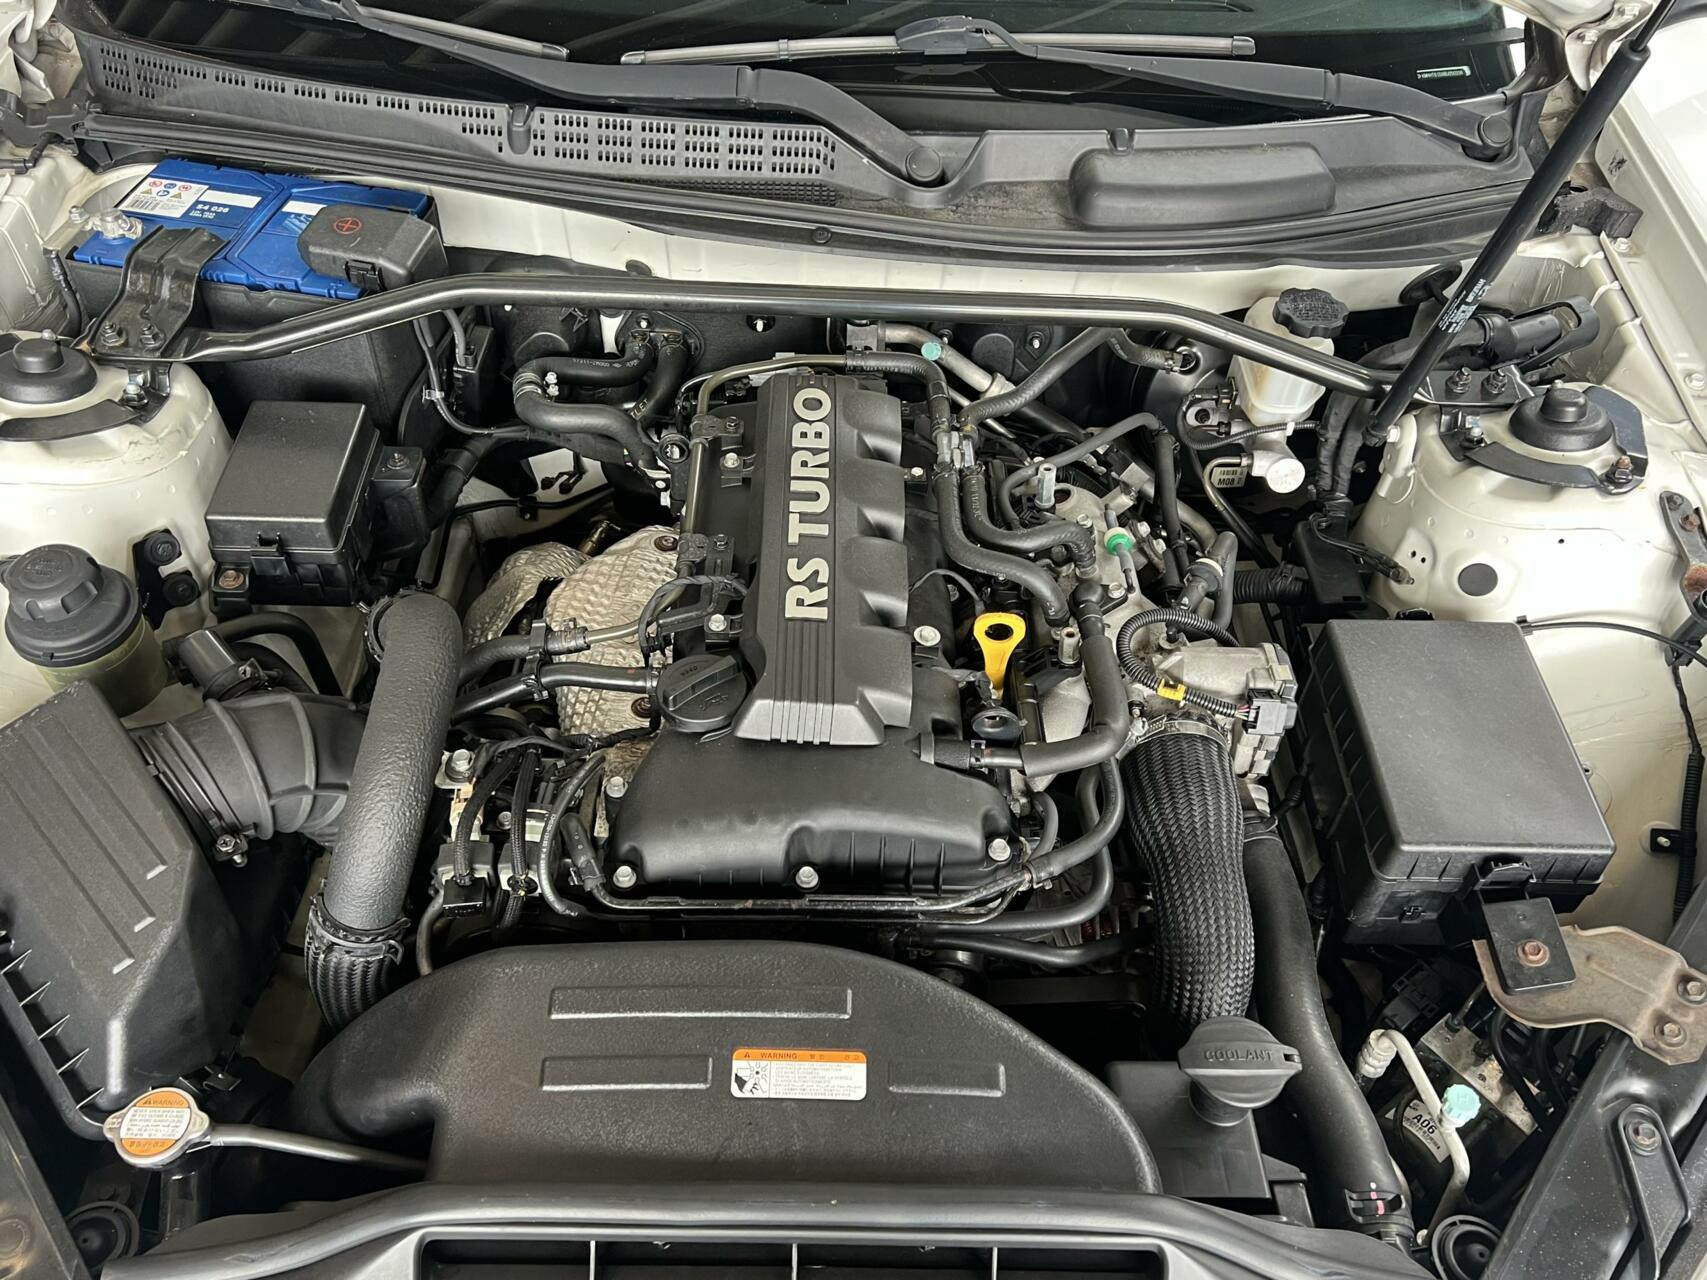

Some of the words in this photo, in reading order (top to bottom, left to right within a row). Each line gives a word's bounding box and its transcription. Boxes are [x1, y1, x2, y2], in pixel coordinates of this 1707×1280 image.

[788, 387, 832, 544] TURBO
[1217, 477, 1236, 486] M08
[785, 558, 830, 620] RS
[760, 1052, 798, 1060] WARNING
[1204, 1048, 1273, 1062] COOLANT
[1411, 1113, 1438, 1135] A06
